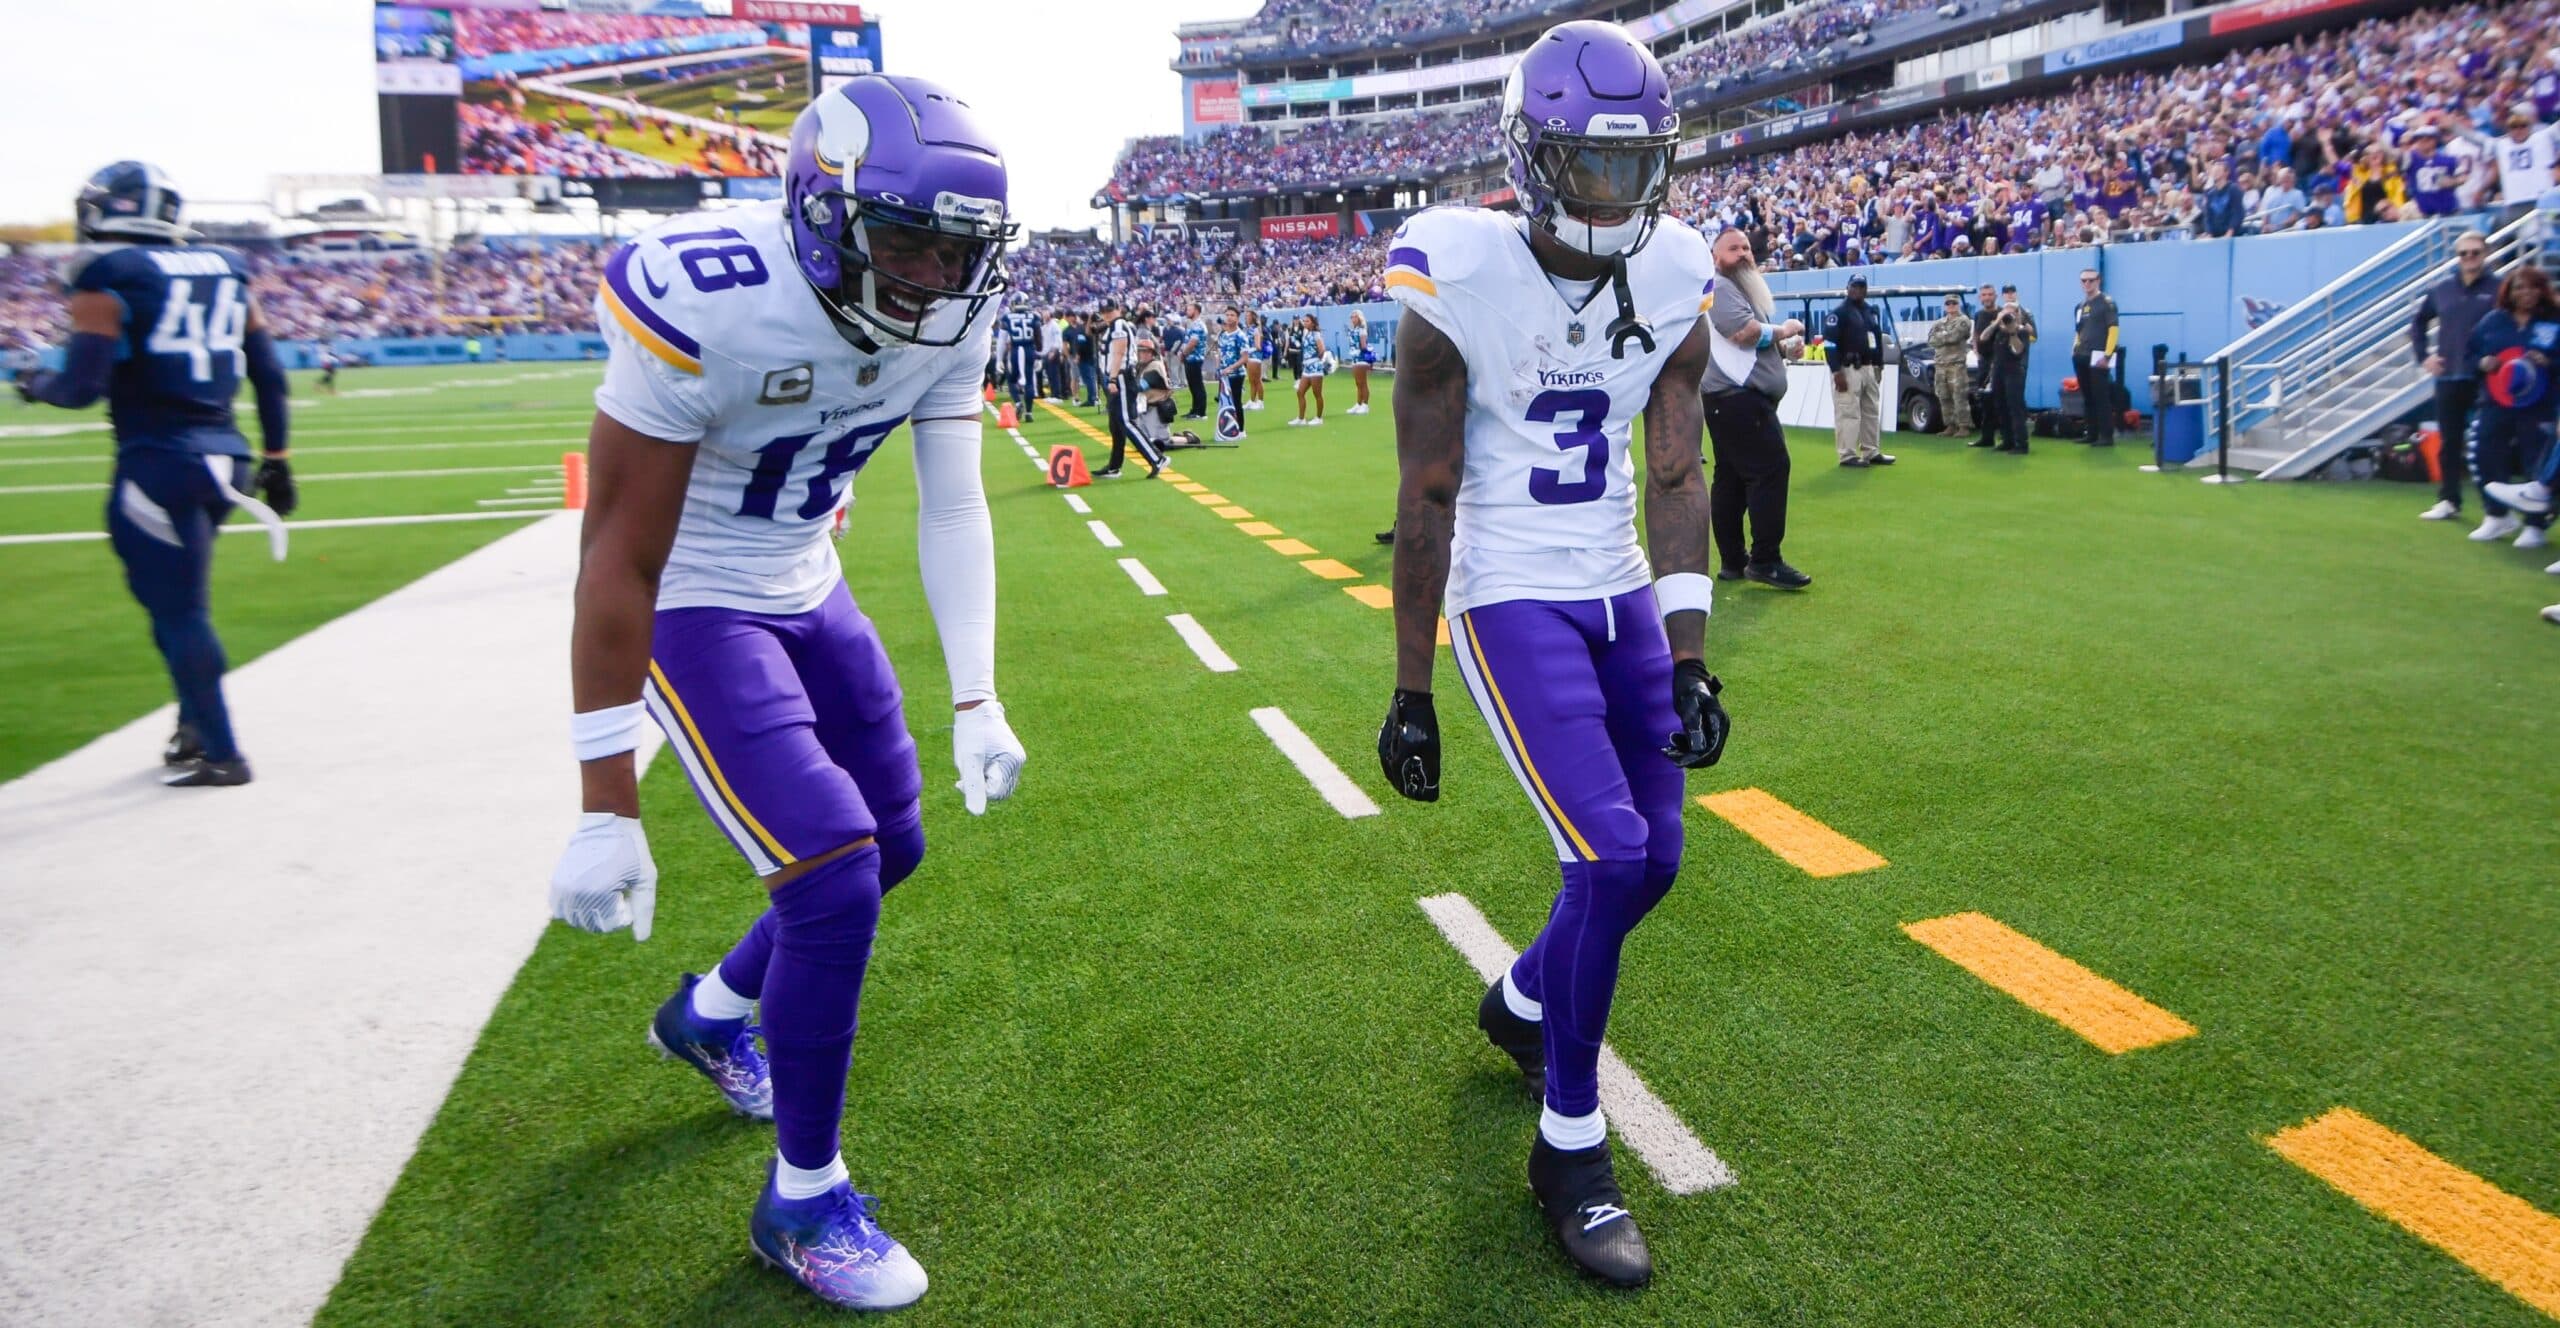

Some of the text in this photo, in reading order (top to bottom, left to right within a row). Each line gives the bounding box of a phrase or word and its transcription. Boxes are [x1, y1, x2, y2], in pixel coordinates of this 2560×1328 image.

[744, 2, 848, 21] NISSAN
[1270, 219, 1329, 234] NISSAN
[1918, 219, 1928, 235] 3
[659, 225, 770, 293] 18
[148, 277, 247, 381] 44
[1010, 318, 1034, 340] 56
[765, 366, 811, 399] C
[1524, 388, 1611, 505] 3
[1051, 448, 1073, 486] G
